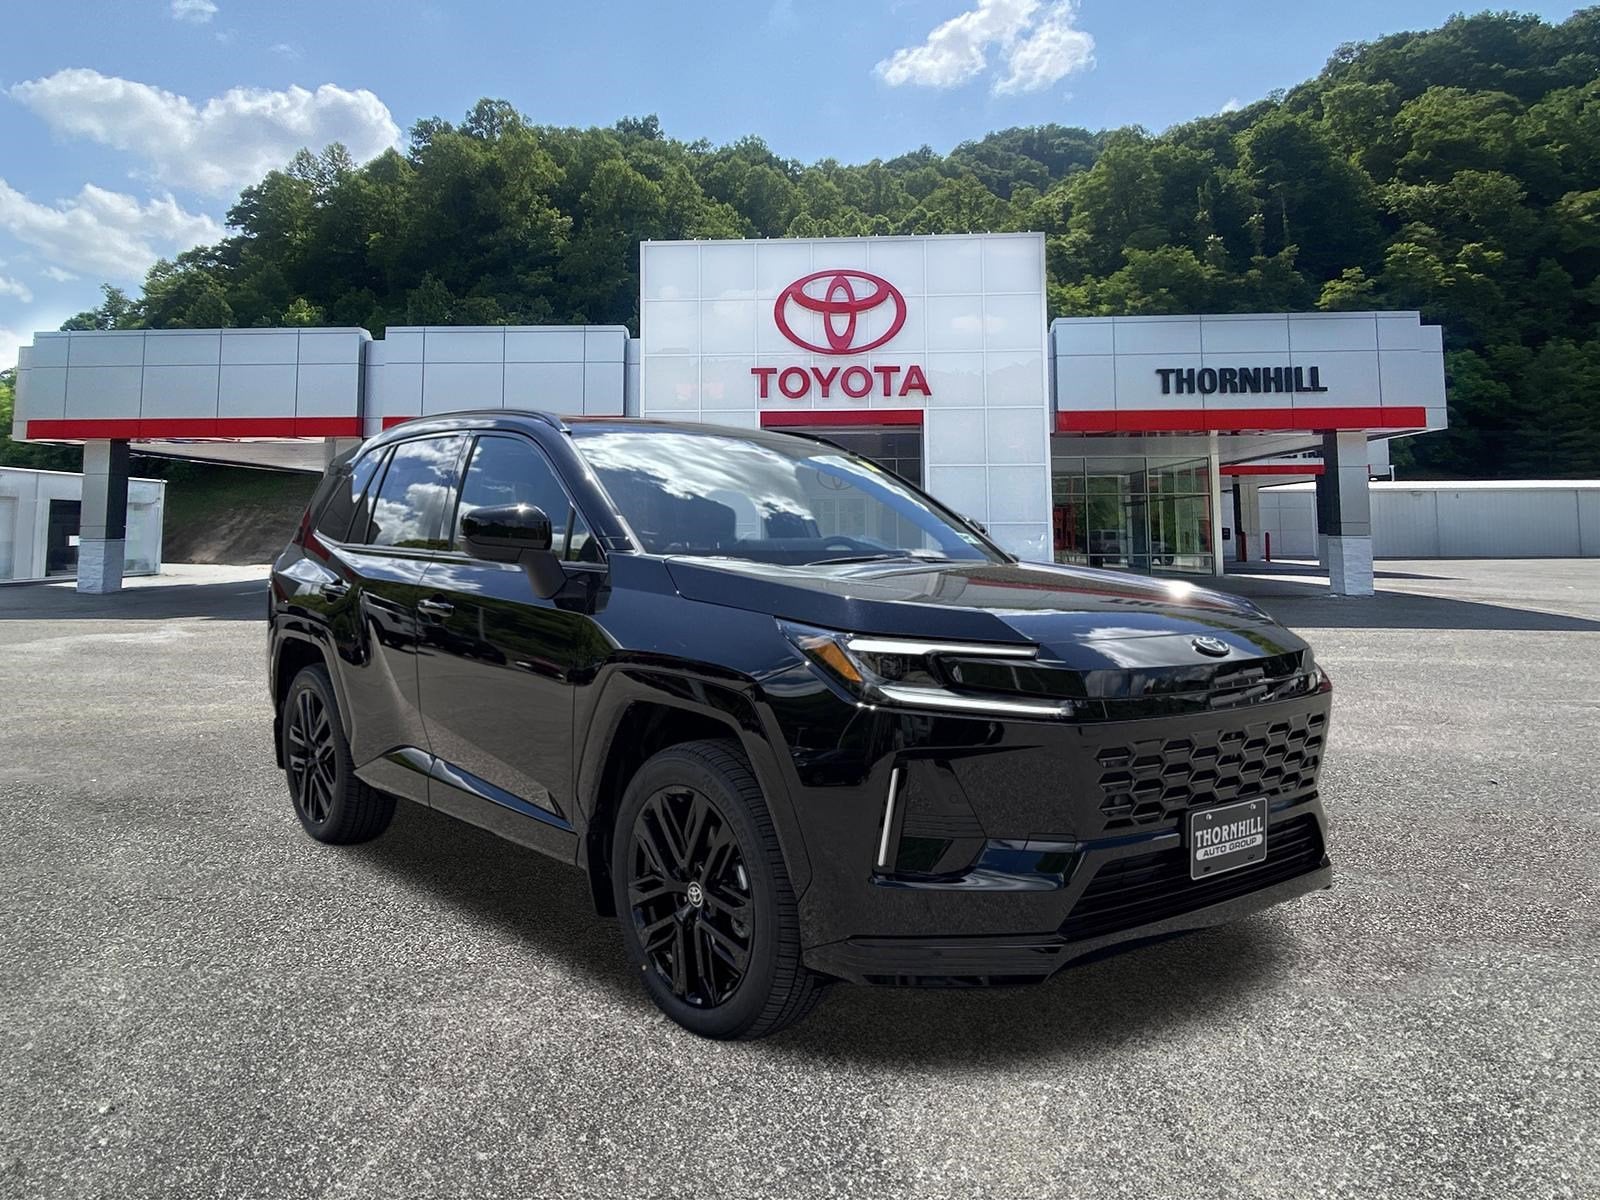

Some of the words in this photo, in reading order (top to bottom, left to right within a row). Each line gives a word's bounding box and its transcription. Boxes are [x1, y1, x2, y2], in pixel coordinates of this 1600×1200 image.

[751, 365, 932, 399] TOYOTA
[1156, 366, 1328, 394] THORNHILL
[1195, 816, 1264, 848] THORNHILL
[1203, 845, 1227, 858] AUTO
[1228, 837, 1257, 851] GROUP
